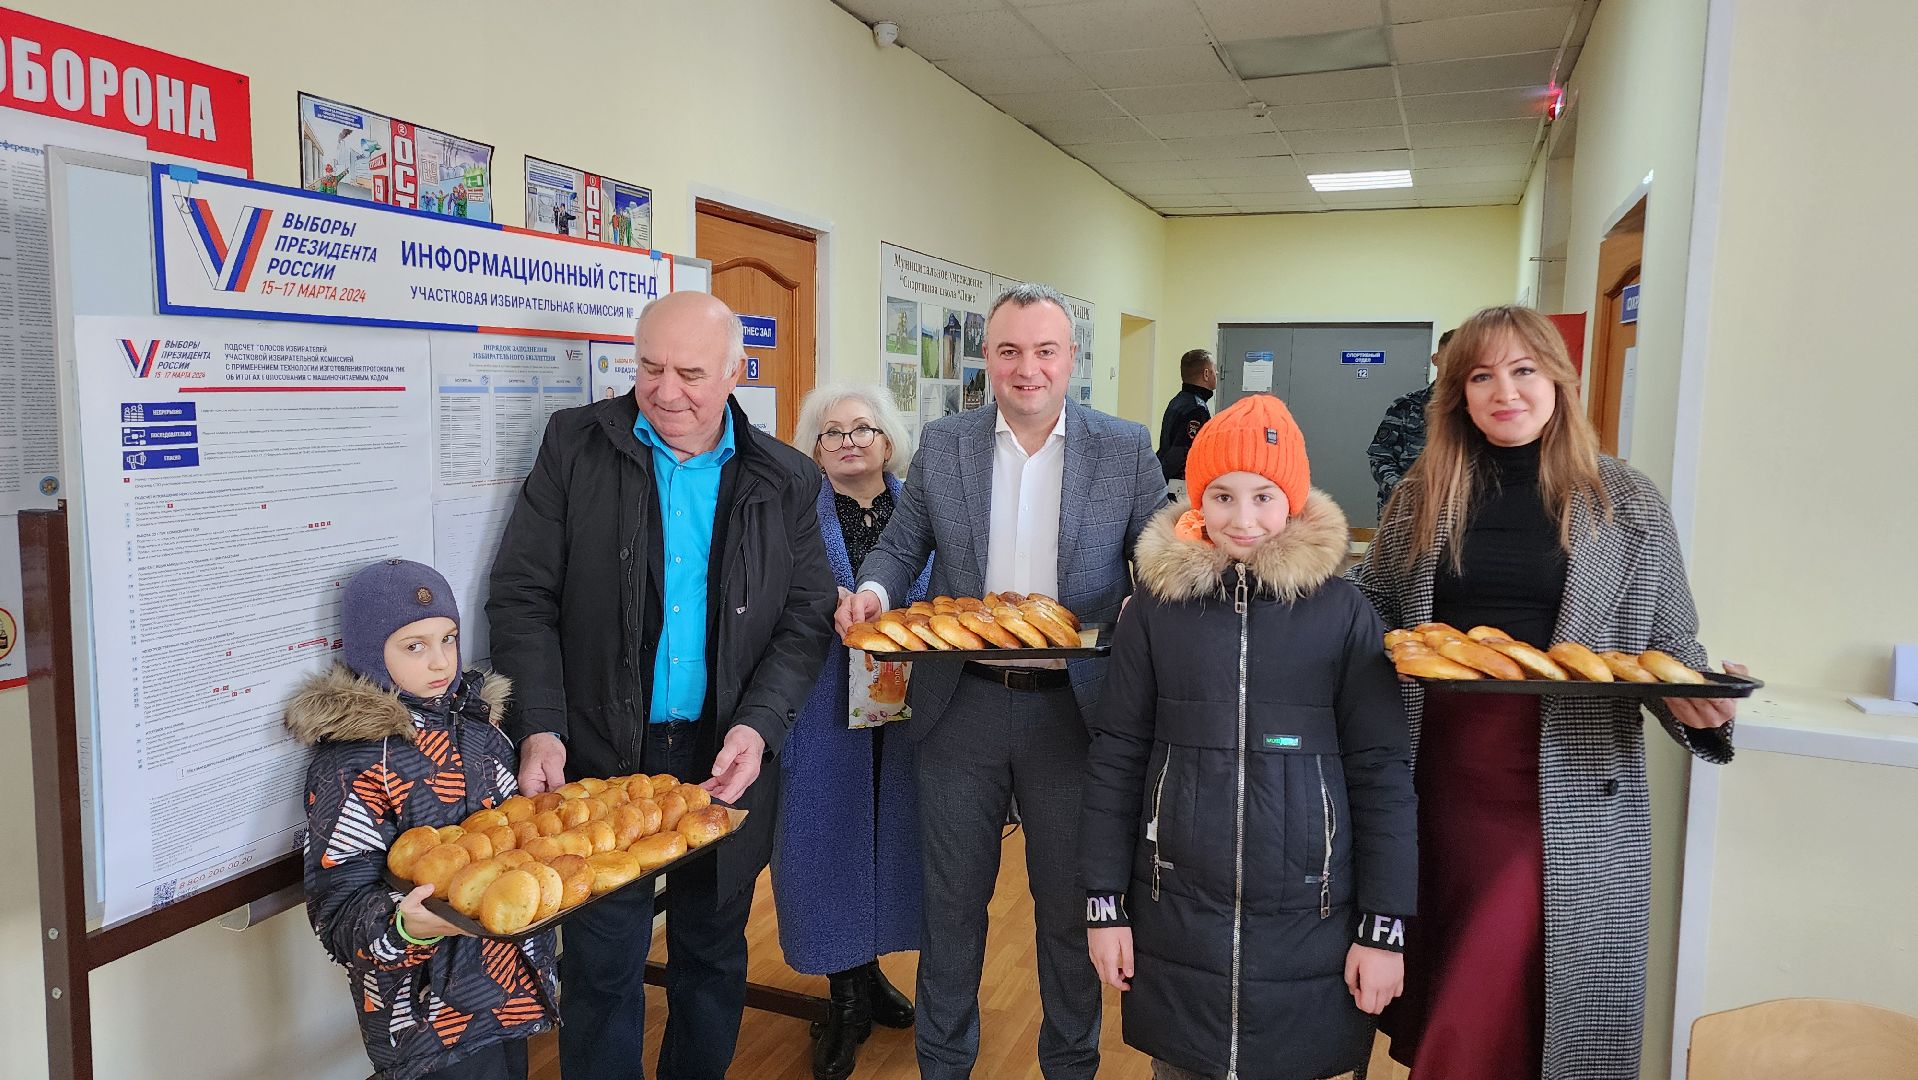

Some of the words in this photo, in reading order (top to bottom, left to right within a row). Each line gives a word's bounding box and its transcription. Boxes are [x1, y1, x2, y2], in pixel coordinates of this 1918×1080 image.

[0, 36, 217, 142] БОРОНА
[282, 212, 357, 237] ВЫБОРЫ
[274, 235, 378, 263] ПРЕЗИДЕНТА
[266, 258, 336, 281] РОССИИ
[401, 240, 604, 289] ИНФОРМАЦИОННЫЙ
[608, 270, 658, 299] СТЕНД
[893, 253, 948, 280] Муниципальное
[297, 283, 338, 301] МАРТА
[339, 287, 367, 303] 2024
[410, 285, 488, 306] УЧАСТКОВАЯ
[490, 294, 575, 314] ИЗБИРАТЕЛЬНАЯ
[577, 303, 624, 318] КОМИССИЯ
[743, 325, 760, 337] ТНЕС
[760, 327, 772, 338] ЗАЛ
[164, 340, 201, 350] ВЫБОРЫ
[224, 343, 254, 352] ПОДСЧЕТ
[286, 345, 328, 353] ИЗБИРАТЕЛЕЙ
[161, 351, 211, 360] ПРЕЗИДЕНТА
[224, 353, 267, 361] УЧАСТКОВОЙ
[268, 354, 319, 362] ИЗБИРАТЕЛЬНОЙ
[320, 355, 354, 363] КОМИССИЕЙ
[157, 361, 190, 370] РОССИИ
[750, 360, 757, 376] 3
[1358, 369, 1367, 378] 12
[172, 371, 191, 379] МАРТА
[241, 855, 253, 865] 20
[1371, 914, 1405, 947] FA
